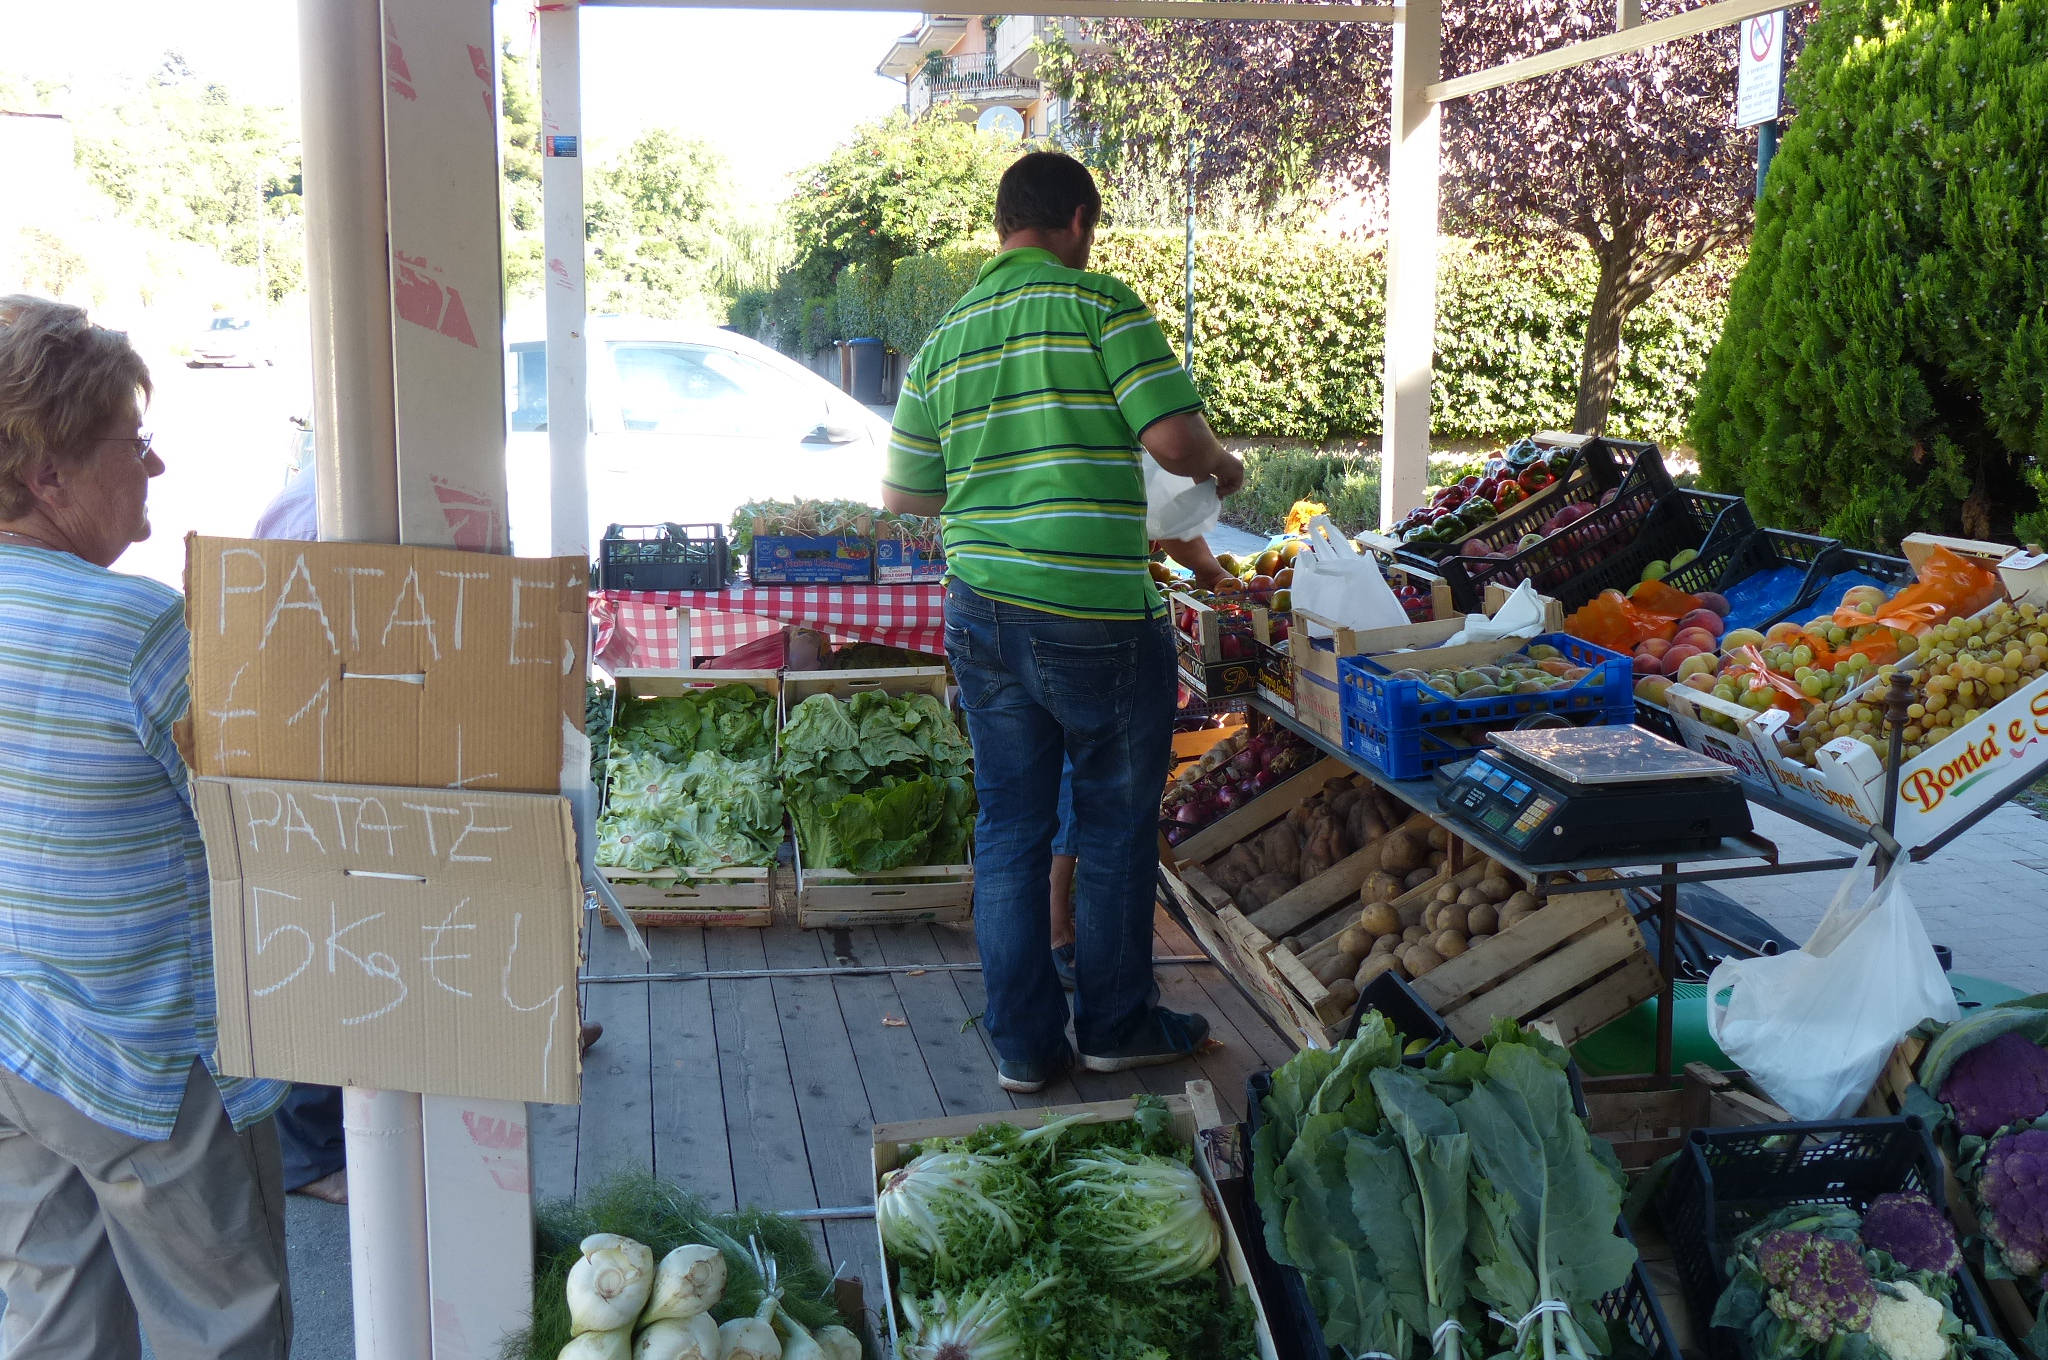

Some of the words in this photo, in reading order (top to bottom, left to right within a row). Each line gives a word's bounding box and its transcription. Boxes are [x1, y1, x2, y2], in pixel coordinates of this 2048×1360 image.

[219, 548, 555, 665] PATATE
[2007, 718, 2028, 744] e
[1807, 780, 1816, 793] e
[242, 788, 513, 862] PATATE
